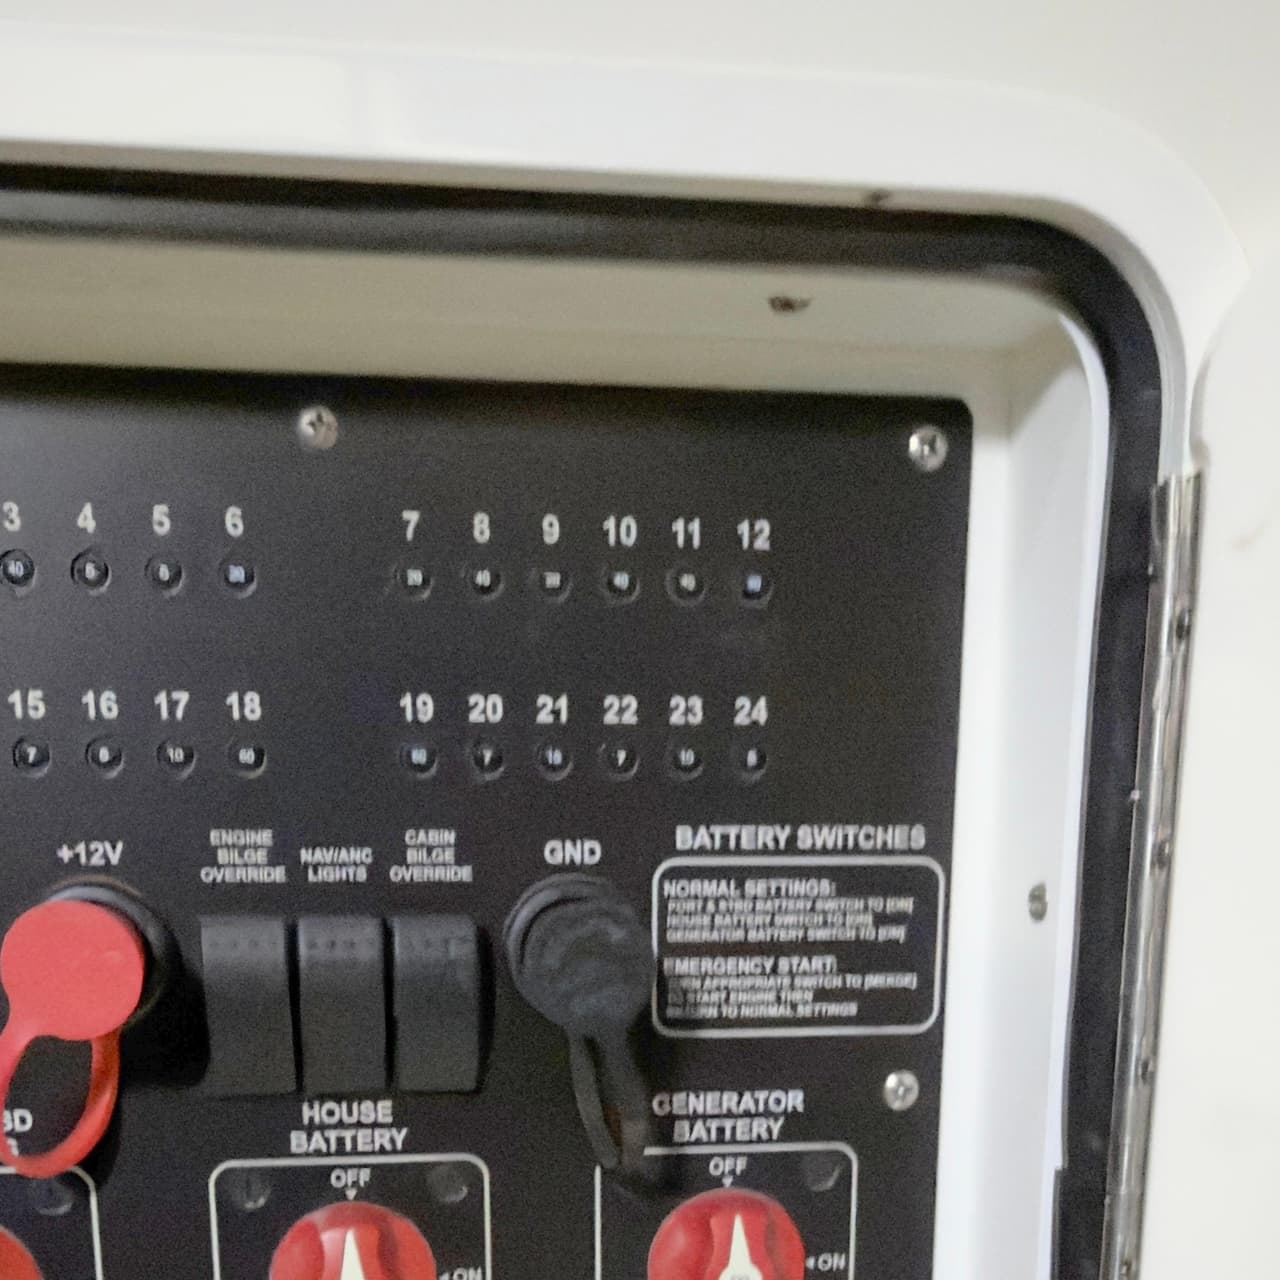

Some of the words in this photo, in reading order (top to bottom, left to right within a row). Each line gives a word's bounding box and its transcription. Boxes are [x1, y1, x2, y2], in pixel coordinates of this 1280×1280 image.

[2, 501, 21, 531] 3
[76, 502, 96, 534] 4
[152, 504, 171, 536] 5
[224, 505, 244, 537] 6
[402, 510, 420, 541] 7
[473, 512, 491, 543] 8
[542, 514, 559, 544] 9
[603, 515, 638, 547] 10
[672, 517, 700, 549] 11
[737, 519, 771, 551] 12
[8, 689, 46, 719] 15
[82, 690, 119, 720] 16
[154, 691, 189, 721] 17
[225, 691, 262, 721] 18
[399, 693, 434, 723] 19
[468, 694, 503, 723] 20
[536, 694, 568, 724] 21
[603, 695, 638, 725] 22
[669, 695, 704, 726] 23
[734, 696, 769, 726] 24
[210, 828, 273, 846] ENGINE
[405, 828, 456, 846] CABIN
[675, 825, 790, 850] BATTERY
[797, 824, 926, 849] SWITCHES
[56, 840, 123, 866] +12V
[217, 848, 268, 864] BILGE
[406, 847, 455, 864] BILGE
[544, 840, 602, 865] GND
[200, 865, 286, 883] OVERRIDE
[307, 865, 367, 883] LIGHTS
[389, 865, 473, 883] OVERRIDE
[664, 879, 740, 898] NORMAL
[664, 956, 775, 976] EMERGENCY
[302, 1100, 393, 1125] HOUSE
[652, 1089, 804, 1115] GENERATOR
[290, 1128, 408, 1154] BATTERY
[673, 1117, 785, 1143] BATTERY
[330, 1168, 371, 1188] OFF
[709, 1156, 748, 1176] OFF
[818, 1253, 845, 1271] ON
